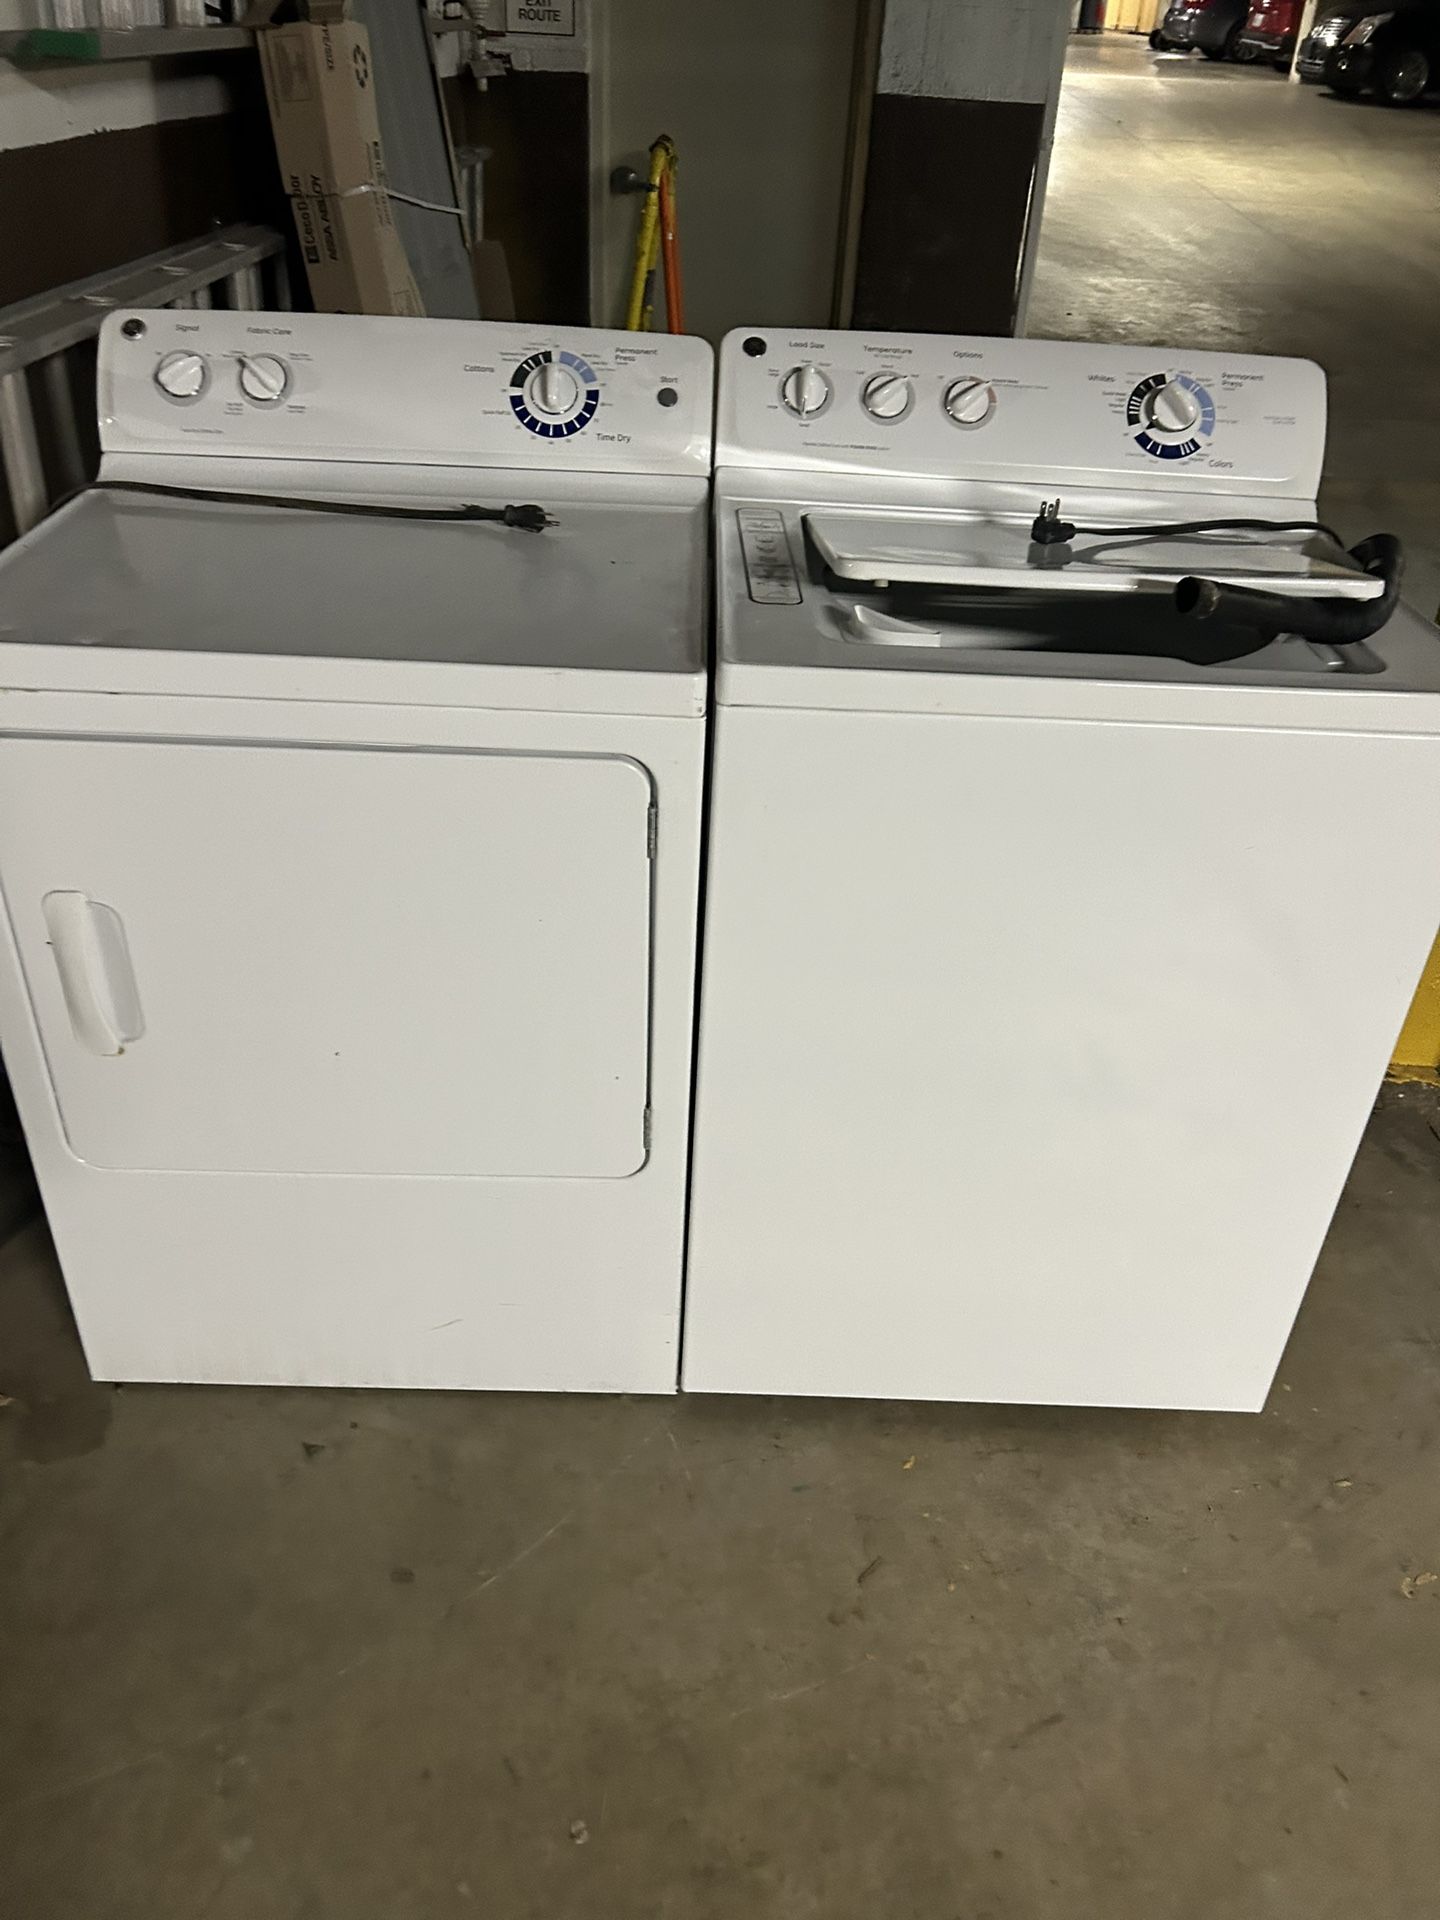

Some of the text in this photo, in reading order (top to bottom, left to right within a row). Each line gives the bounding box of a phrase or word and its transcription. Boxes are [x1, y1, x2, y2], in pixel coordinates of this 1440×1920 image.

[518, 7, 561, 22] ROUTE
[175, 324, 200, 333] Signal
[246, 326, 292, 335] Fabric Care
[788, 341, 808, 349] Load
[863, 344, 913, 355] Temperature
[615, 347, 658, 355] Permanent
[953, 350, 983, 359] Options
[615, 354, 636, 362] Press
[463, 364, 495, 373] Cottons
[1088, 374, 1116, 382] Whites
[1221, 372, 1265, 381] Permanent
[1221, 380, 1243, 388] Press
[596, 433, 632, 443] Time Dry
[1208, 459, 1234, 468] Colors
